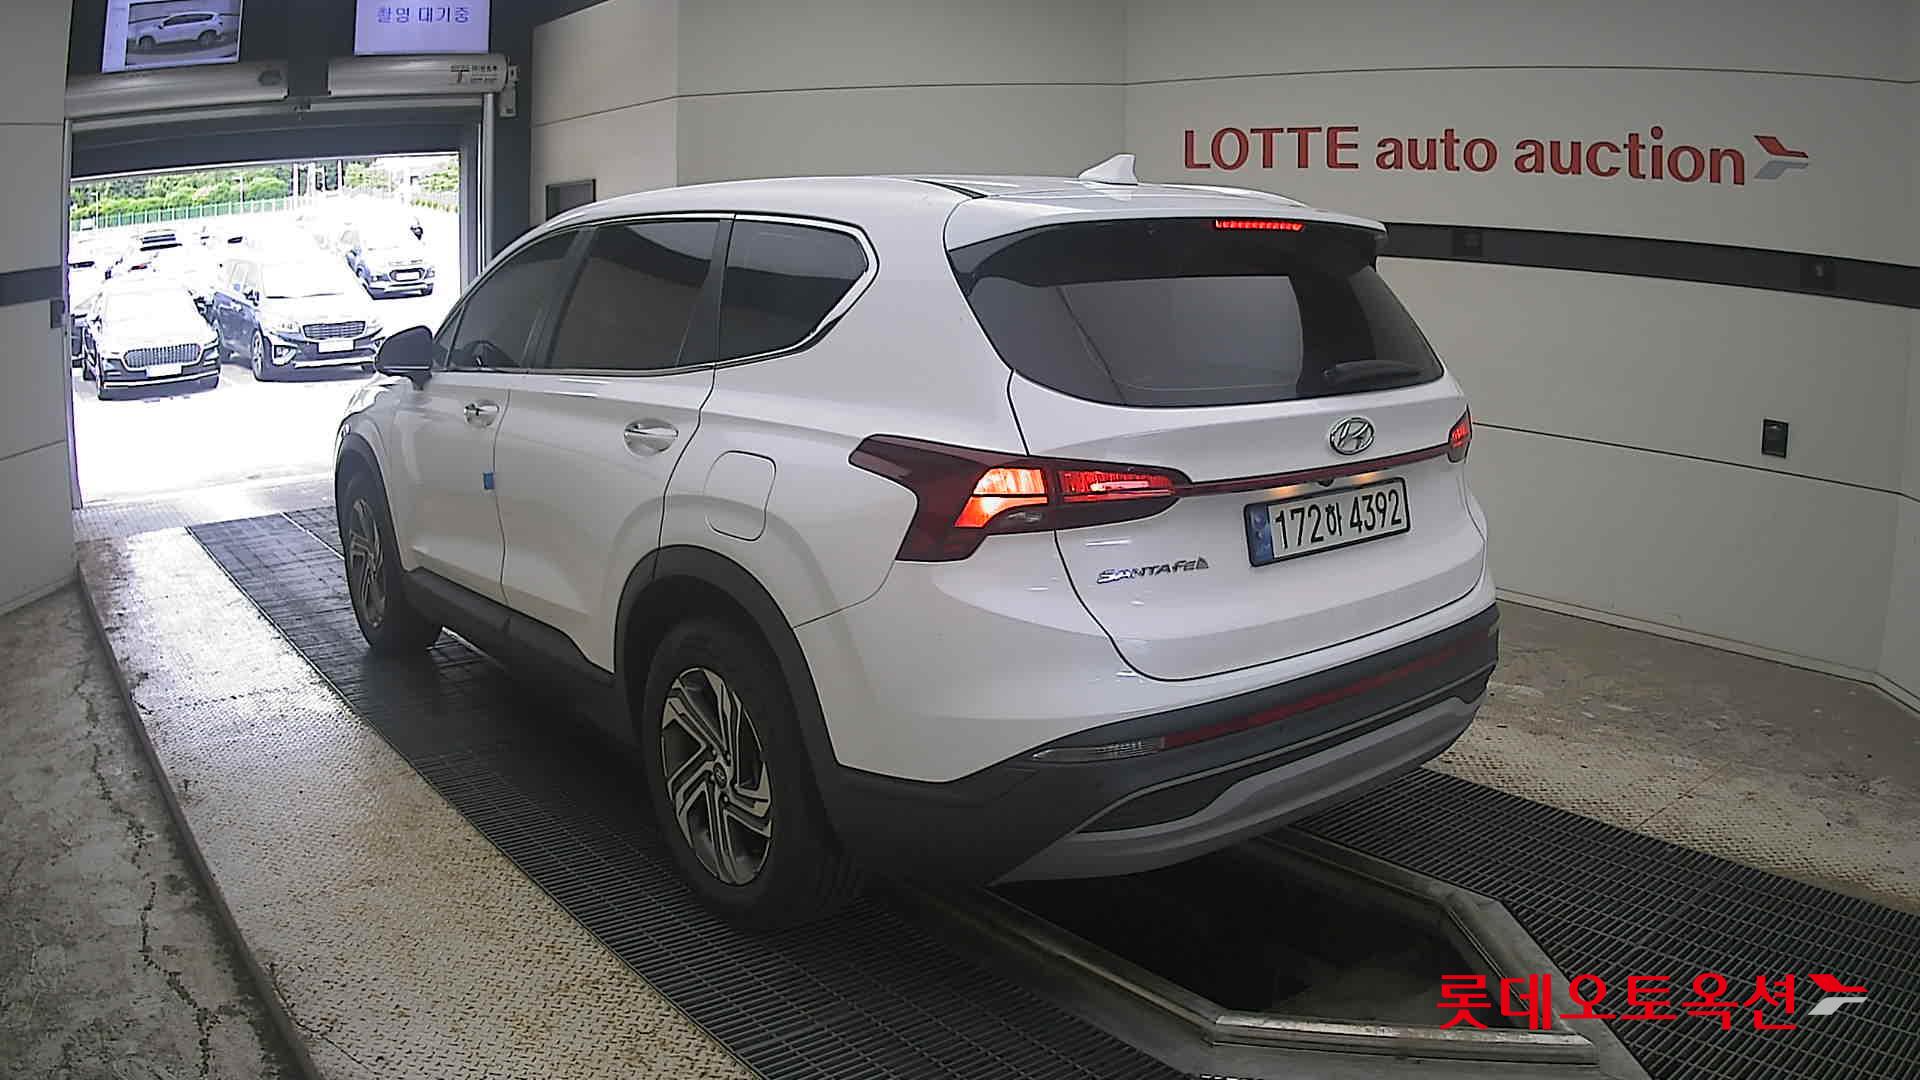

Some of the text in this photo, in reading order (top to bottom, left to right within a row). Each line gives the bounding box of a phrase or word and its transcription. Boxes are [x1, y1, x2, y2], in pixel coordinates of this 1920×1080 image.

[418, 6, 469, 24] 대기중
[1183, 124, 1746, 186] LOTTE auto auction
[1274, 488, 1402, 550] 172하 4392
